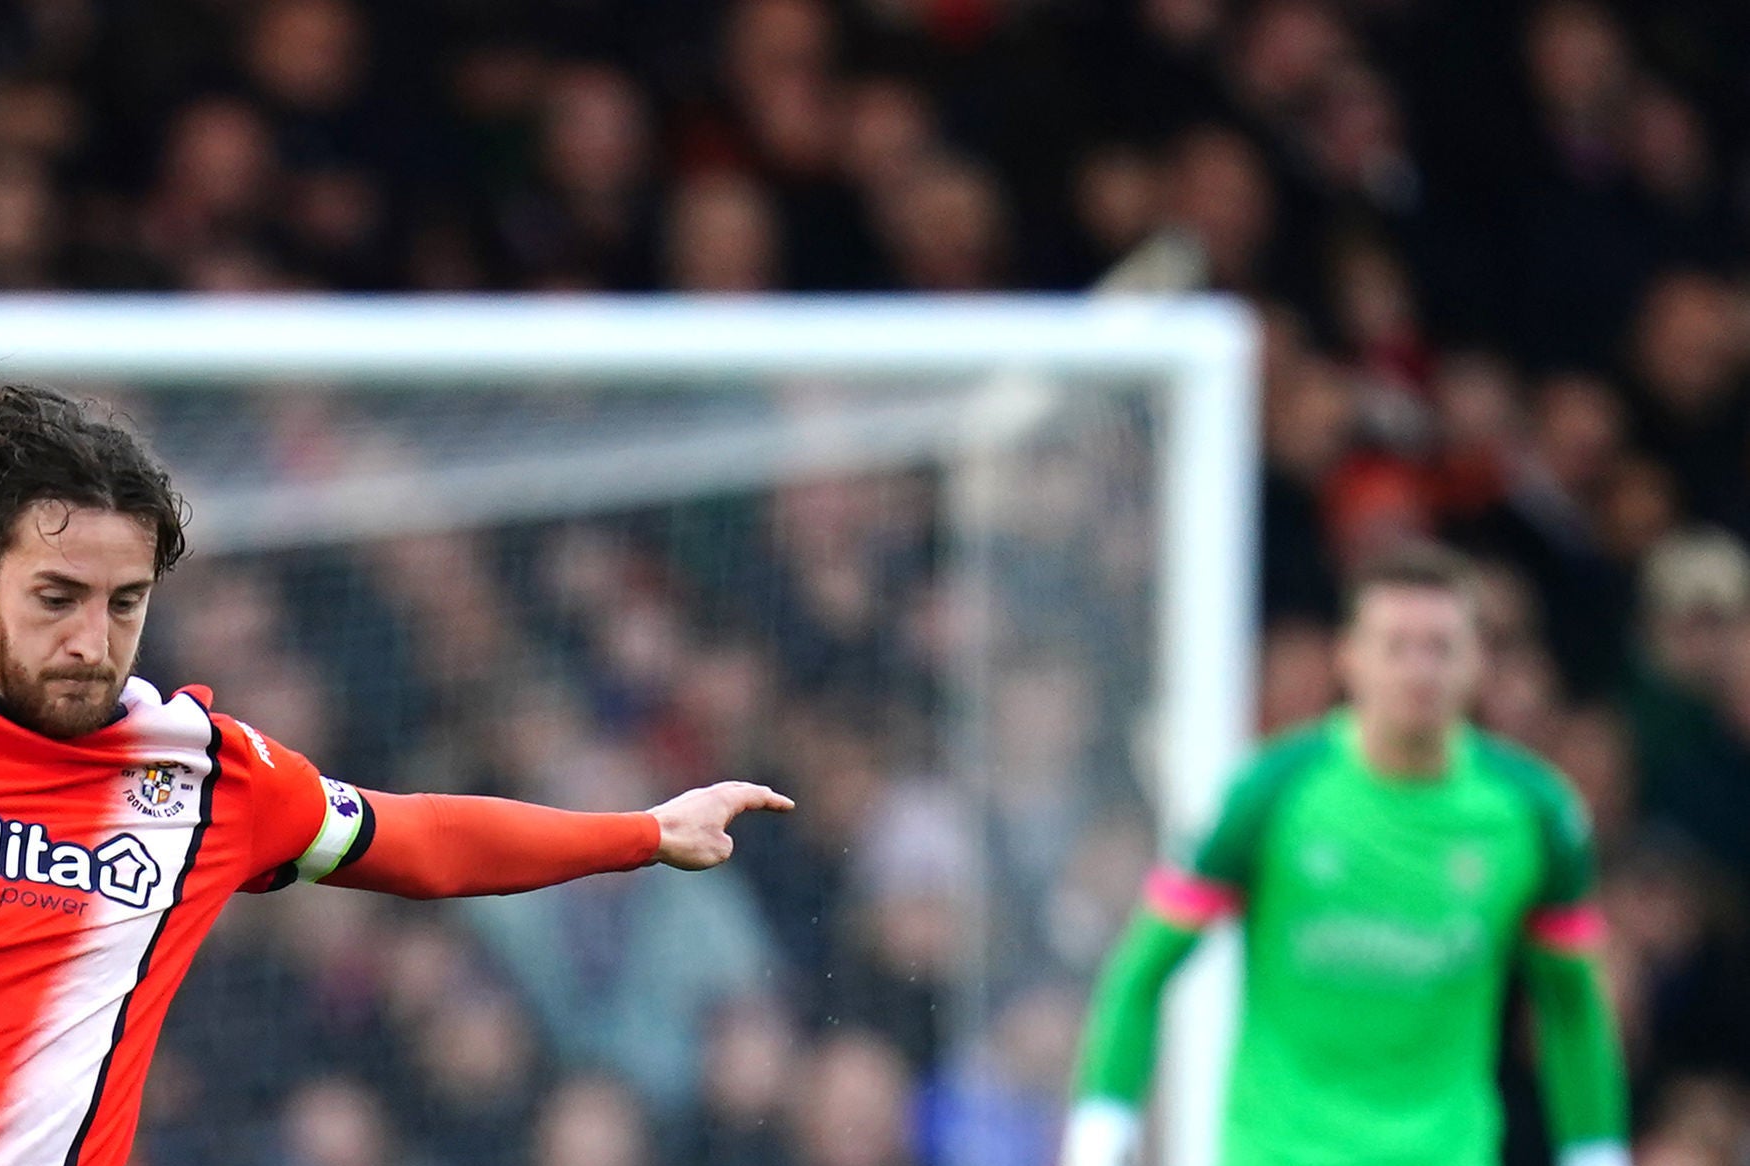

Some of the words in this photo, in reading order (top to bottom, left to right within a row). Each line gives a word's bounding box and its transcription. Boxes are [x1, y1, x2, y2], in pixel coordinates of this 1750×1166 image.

[122, 788, 163, 818] FOOTBALL
[164, 800, 185, 818] CLUB
[0, 886, 89, 917] power
